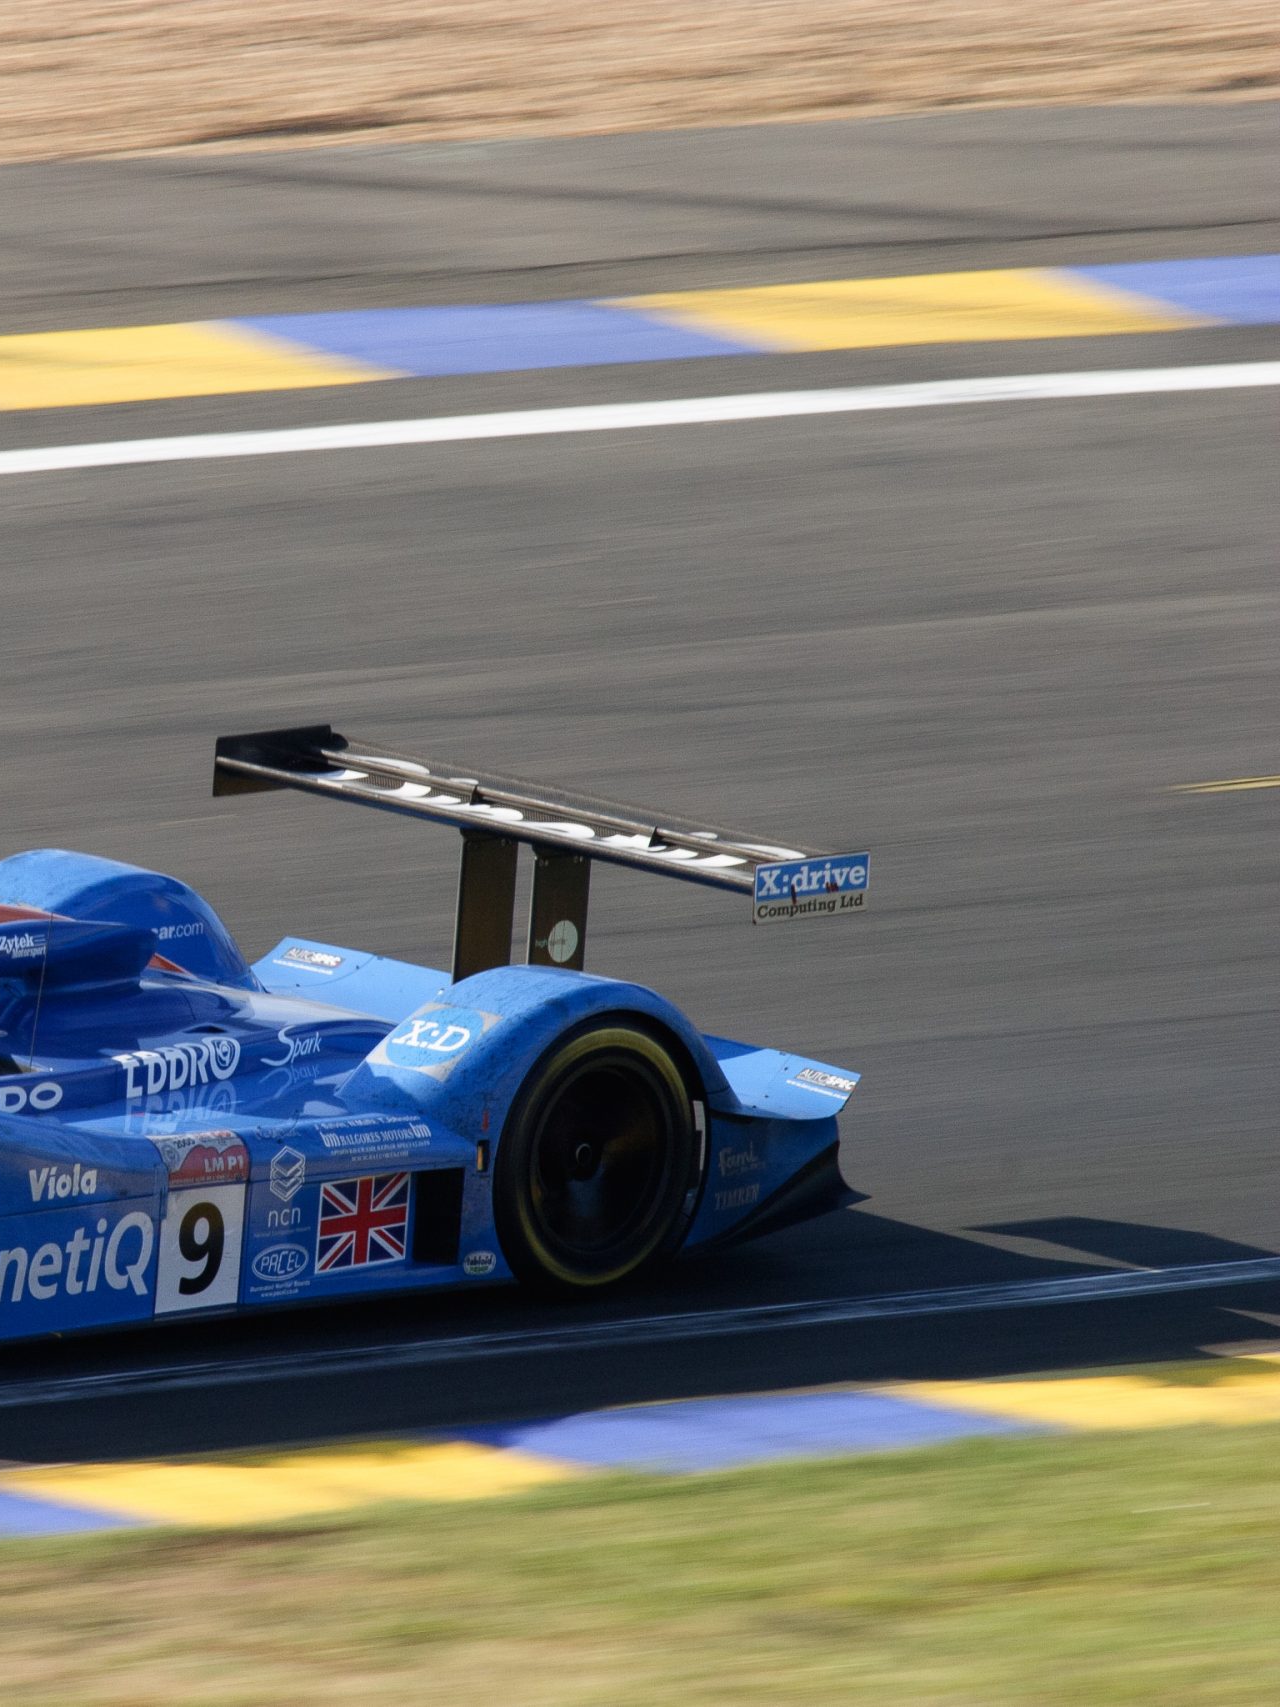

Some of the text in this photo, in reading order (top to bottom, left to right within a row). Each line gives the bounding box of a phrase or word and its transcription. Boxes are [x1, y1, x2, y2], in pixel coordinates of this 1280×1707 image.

[758, 862, 866, 897] X:drive
[757, 893, 864, 919] Computing Ltd
[260, 1025, 321, 1068] Spark
[391, 1019, 471, 1052] X:D
[340, 1131, 381, 1146] BALGORES
[380, 1128, 415, 1142] MOTORS
[205, 1154, 245, 1173] LM P1
[29, 1163, 98, 1202] Viola
[267, 1206, 301, 1228] ncn
[178, 1201, 225, 1295] 9
[260, 1250, 301, 1275] PACEL
